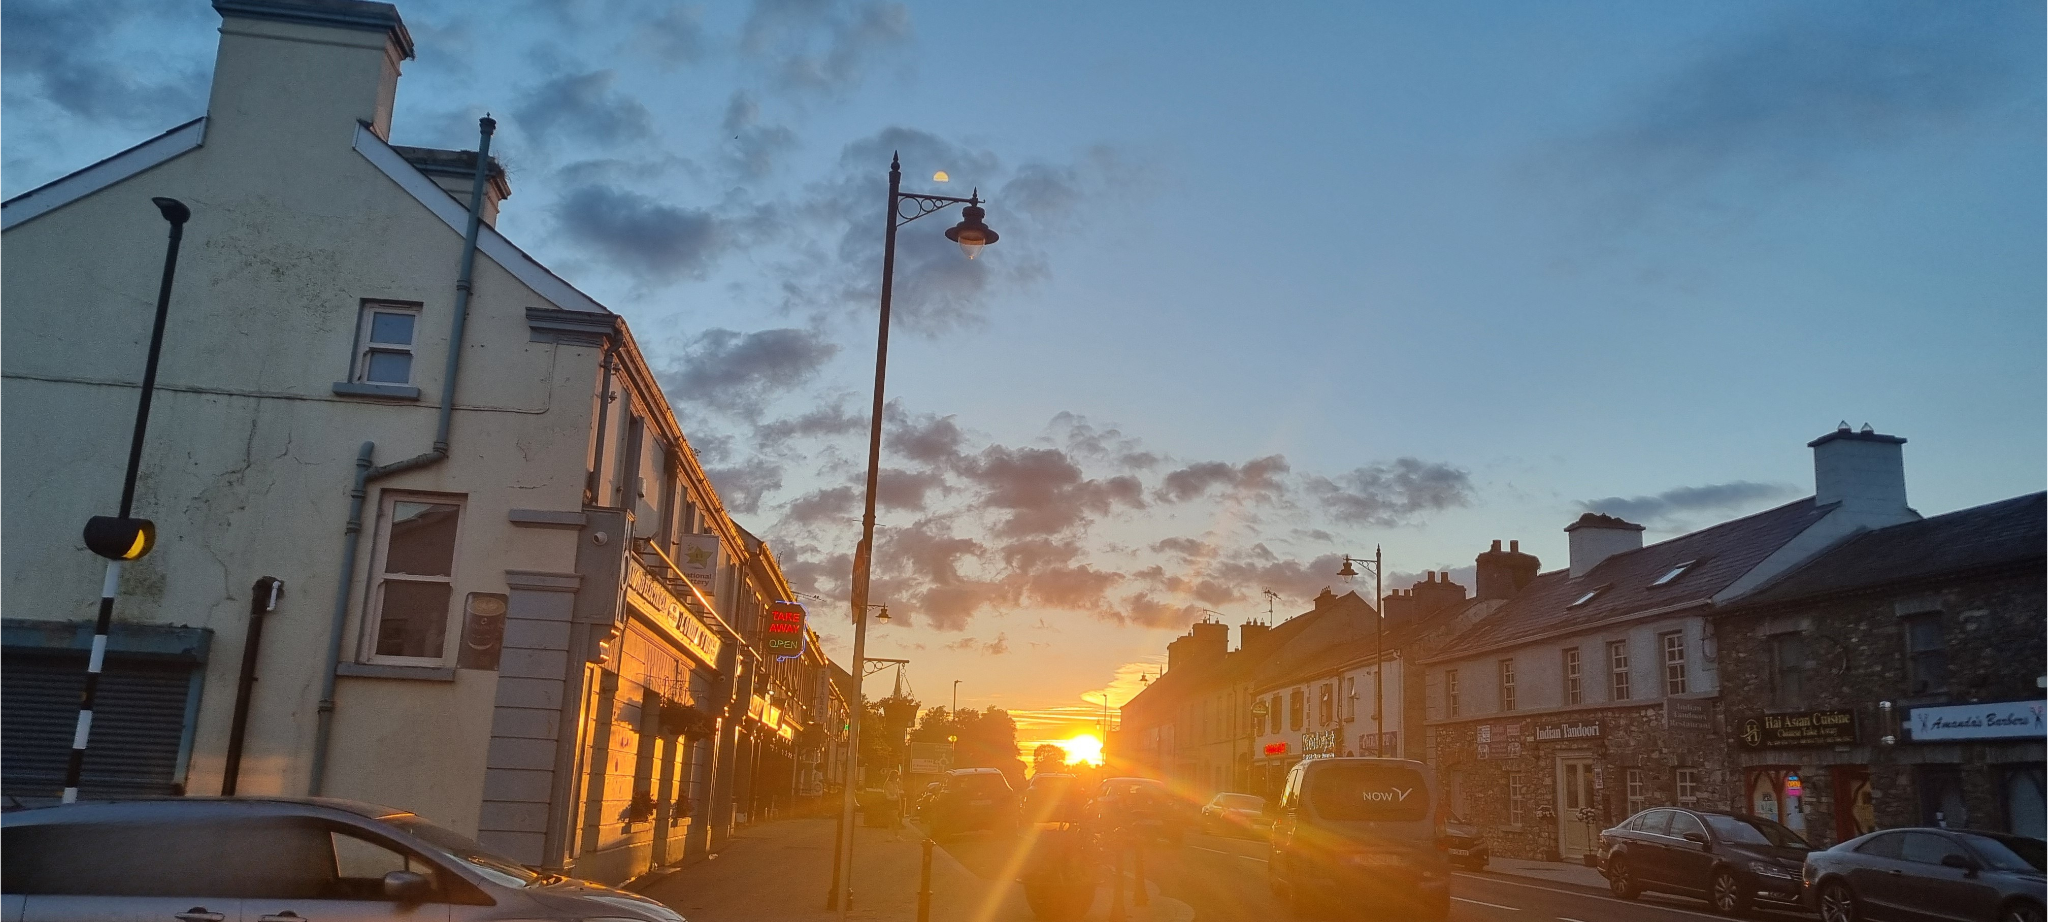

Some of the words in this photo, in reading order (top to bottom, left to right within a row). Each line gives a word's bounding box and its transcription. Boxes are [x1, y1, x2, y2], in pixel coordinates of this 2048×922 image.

[771, 611, 800, 622] TAKE
[769, 623, 799, 633] AWAY
[769, 639, 798, 649] OPEN
[1766, 716, 1782, 728] Hai
[1813, 712, 1851, 725] Cuisine
[1931, 716, 1982, 730] Amanda's
[1985, 713, 2030, 727] Barbers
[1536, 725, 1561, 740] Indian
[1562, 721, 1600, 738] Tandoori
[1363, 791, 1393, 801] NOW
